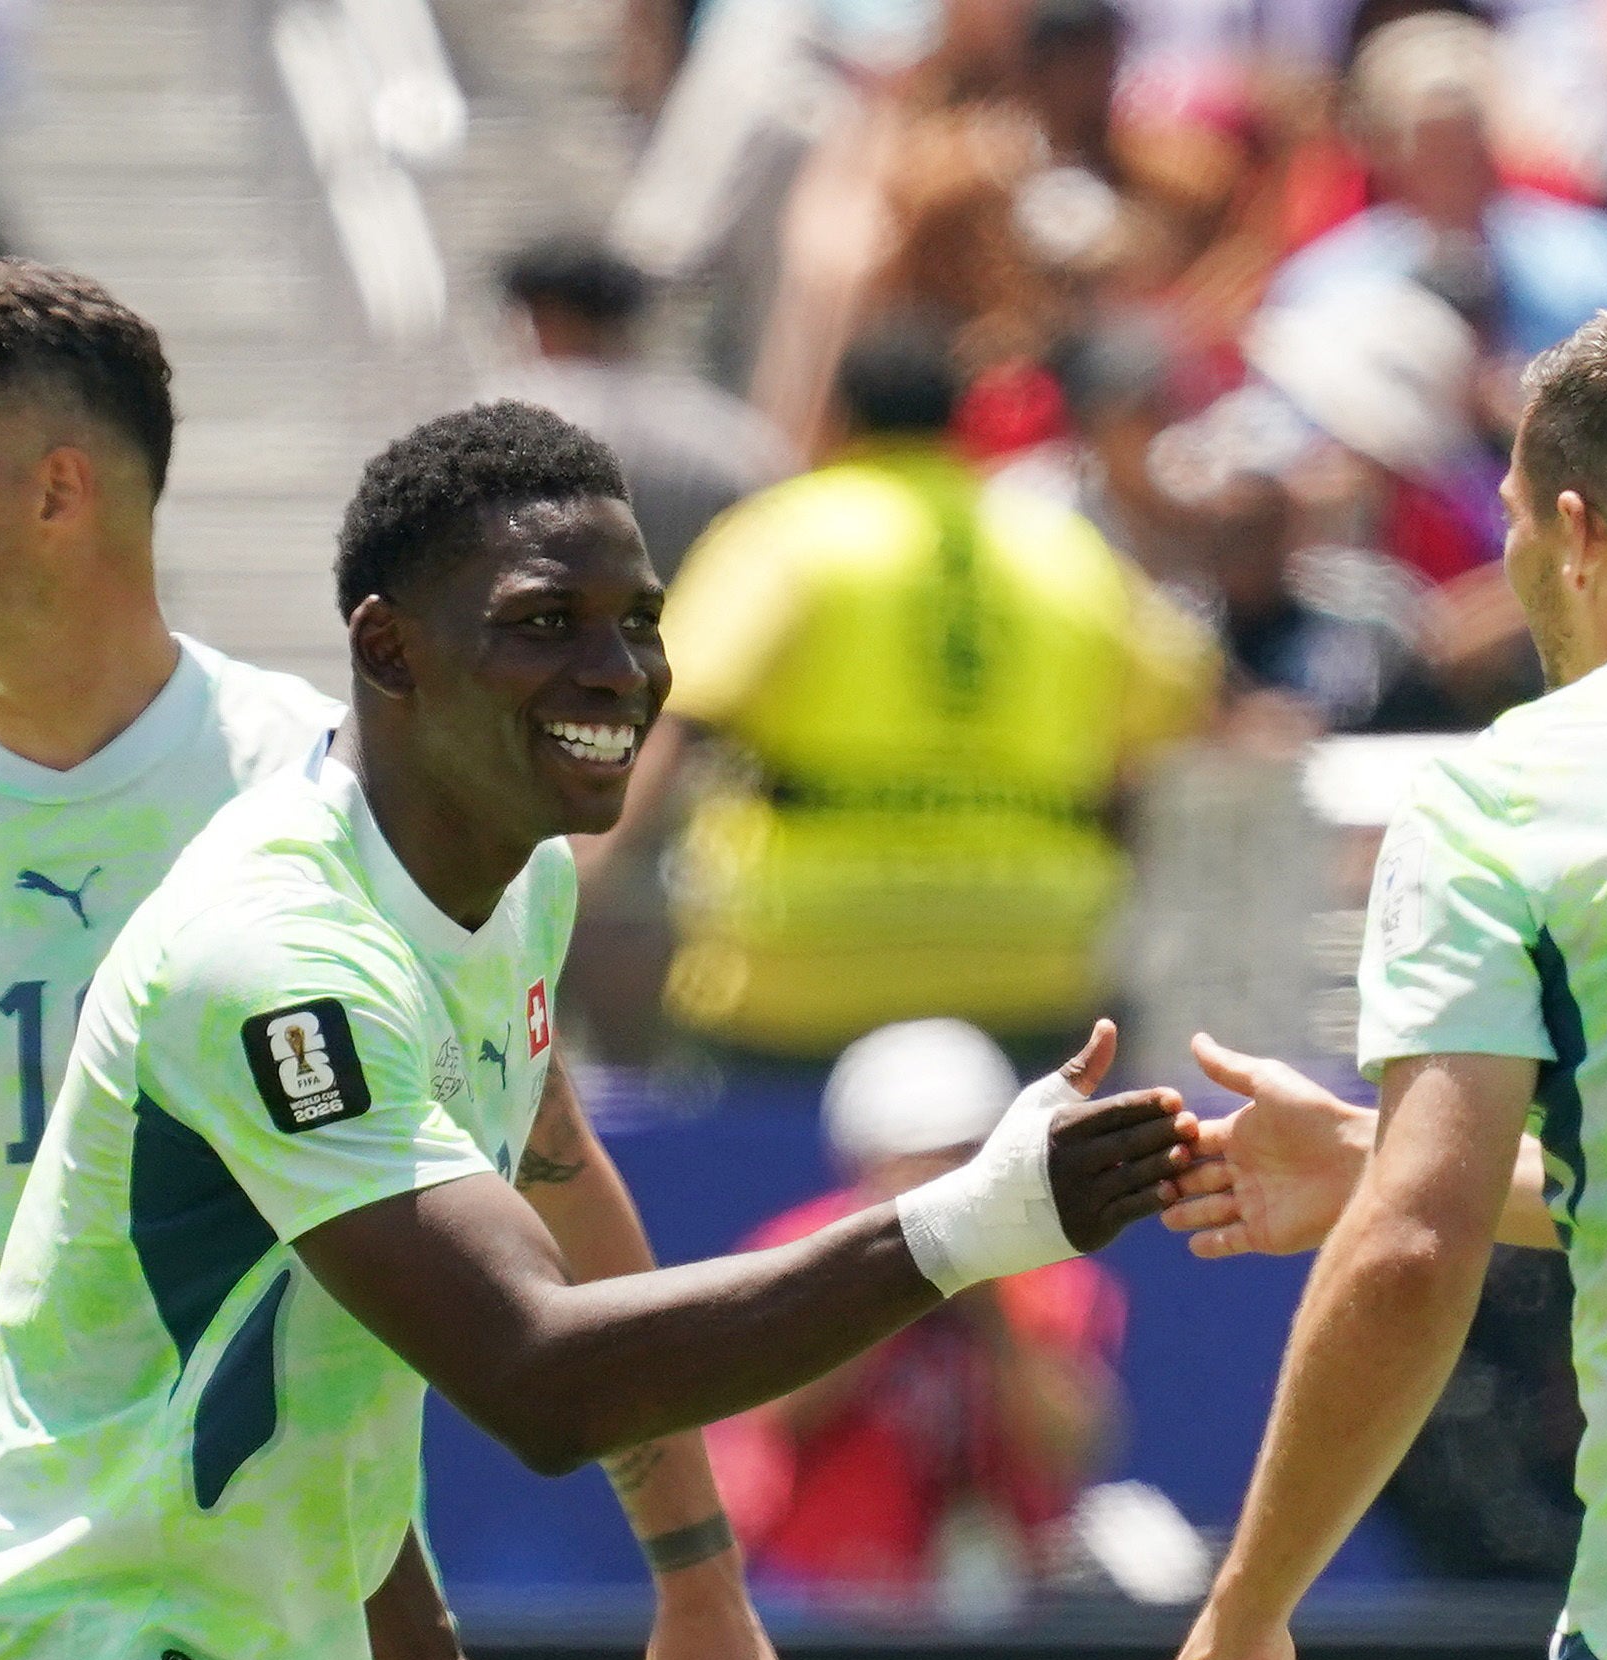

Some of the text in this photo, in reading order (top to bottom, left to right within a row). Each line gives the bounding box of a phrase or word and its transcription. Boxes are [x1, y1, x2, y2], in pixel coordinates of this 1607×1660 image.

[298, 1076, 320, 1088] FIFA
[322, 1090, 340, 1101] CUP
[294, 1098, 344, 1122] 2026
